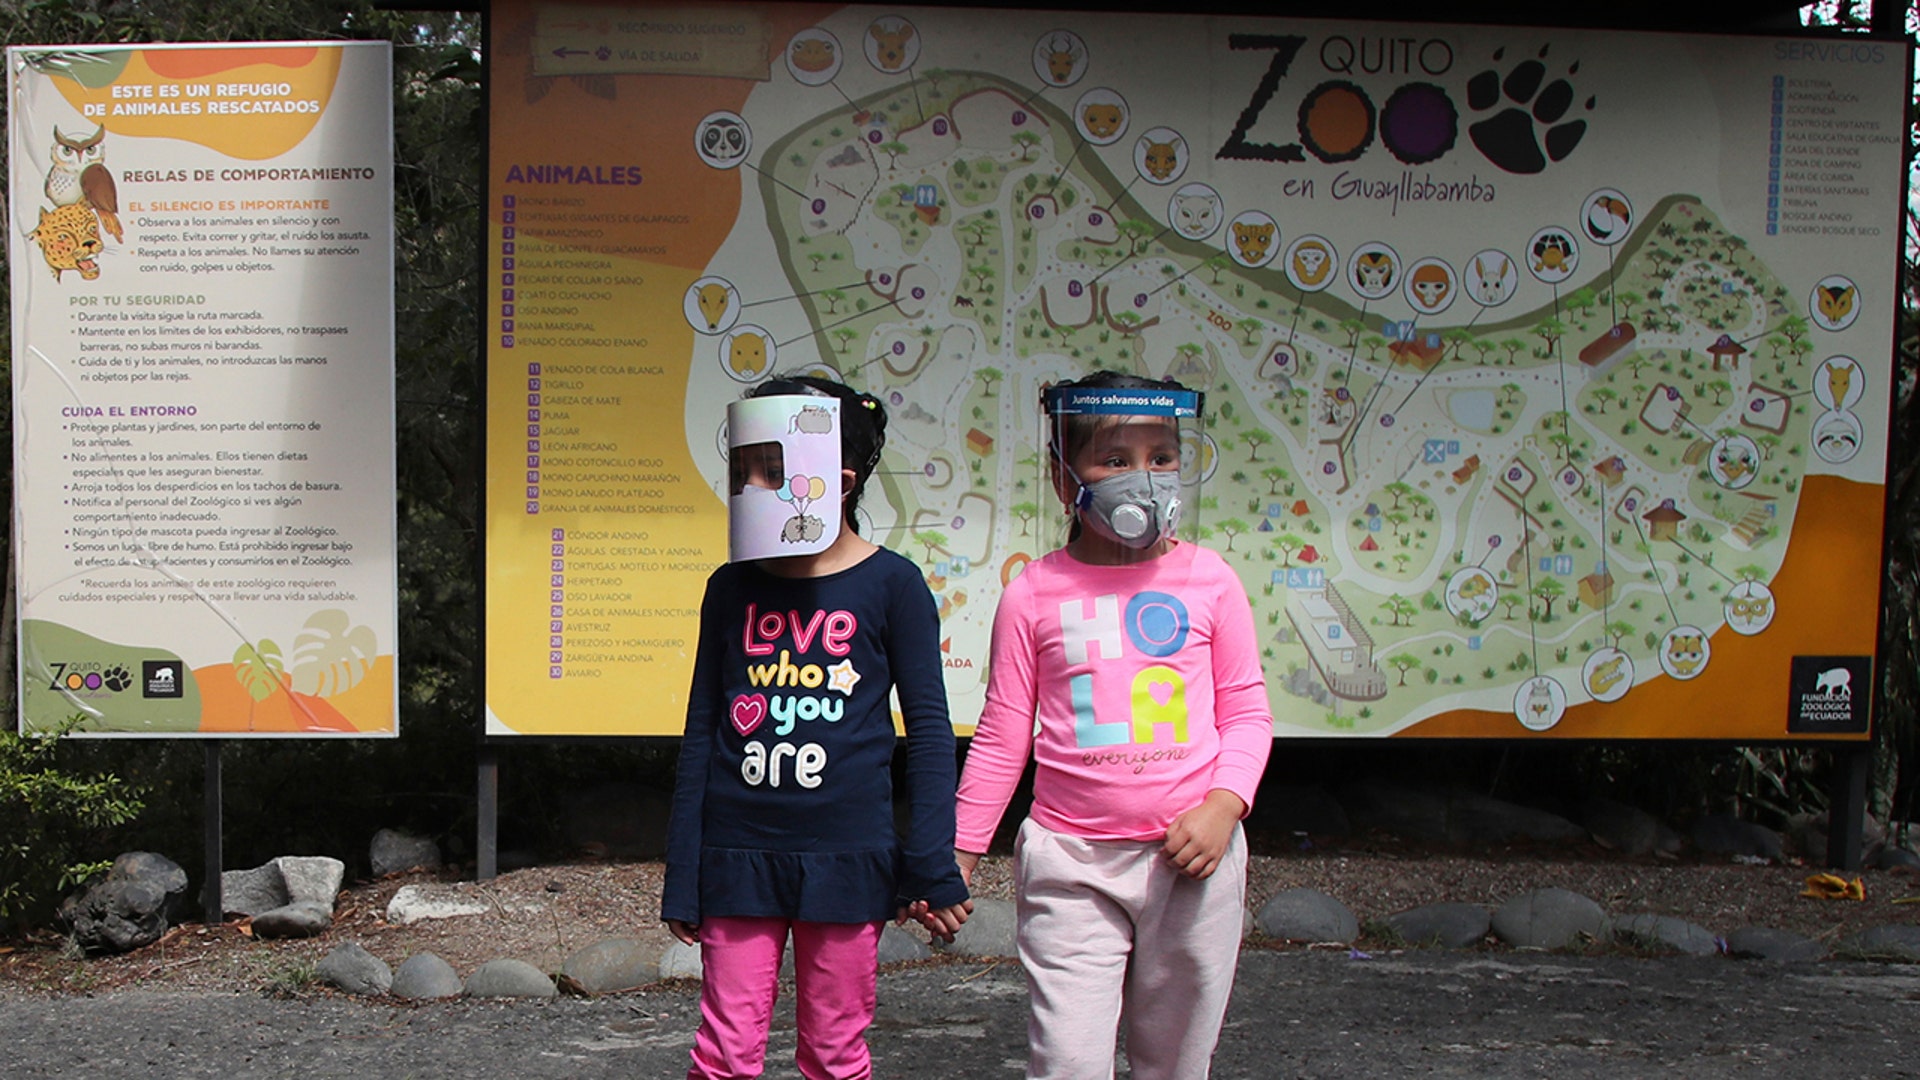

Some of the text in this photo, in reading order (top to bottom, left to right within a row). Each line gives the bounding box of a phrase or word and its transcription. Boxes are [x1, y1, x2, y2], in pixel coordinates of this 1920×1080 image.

[1320, 36, 1454, 76] QUITO
[1774, 41, 1885, 64] SERVICIOS
[112, 83, 291, 98] ESTE ES UN REFUGIO
[84, 100, 320, 116] DE ANIMALES RESCATADOS
[123, 167, 375, 183] REGLAS DE COMPORTAMIENTO
[505, 164, 642, 185] ANIMALES
[1283, 170, 1495, 216] en Guayllabamba
[129, 199, 330, 212] EL SILENCIO ES IMPORTANTE
[138, 217, 181, 227] Observa
[192, 216, 207, 226] los
[210, 216, 254, 226] animales
[256, 218, 270, 226] en
[272, 216, 310, 226] silencio
[312, 218, 319, 228] y
[321, 217, 340, 225] con
[70, 295, 206, 306] POR TU SEGURIDAD
[78, 310, 264, 323] Durante la visita sigue la ruta marcada.
[518, 307, 538, 315] OSO
[541, 307, 578, 315] ANDINO
[1206, 310, 1232, 331] ZOO
[518, 338, 556, 346] VENADO
[559, 338, 611, 347] COLORADO
[614, 339, 648, 347] ENANO
[600, 366, 625, 374] COLA
[545, 381, 584, 389] TIGRILLO
[544, 396, 579, 404] CABEZA
[596, 397, 621, 405] MATE
[1072, 395, 1100, 405] Juntos
[1102, 394, 1149, 406] salvamos
[61, 406, 197, 417] CUIDA EL ENTORNO
[70, 422, 110, 435] Protege
[112, 422, 147, 434] plantas
[149, 425, 155, 434] y
[157, 422, 197, 434] jardines,
[220, 423, 246, 433] parte
[248, 421, 264, 431] del
[266, 422, 306, 431] entorno
[308, 421, 321, 431] de
[544, 427, 579, 435] JAGUAR
[571, 443, 617, 451] AFRICANO
[543, 458, 574, 466] MONO
[576, 458, 636, 467] COTONCILLO
[71, 482, 102, 494] Arroja
[105, 483, 134, 492] todos
[137, 482, 152, 491] los
[154, 482, 218, 494] desperdicios
[236, 481, 251, 491] los
[253, 481, 287, 491] tachos
[289, 481, 303, 491] de
[305, 481, 342, 491] basura.
[543, 489, 573, 497] MONO
[576, 489, 614, 497] LANUDO
[611, 532, 648, 540] ANDINO
[567, 577, 622, 586] HERPETARIO
[590, 593, 632, 601] LAVADOR
[566, 623, 610, 631] AVESTRUZ
[70, 662, 102, 672] QUITO
[566, 669, 601, 677] AVIARIO
[748, 650, 824, 688] who
[770, 695, 844, 736] you
[742, 740, 826, 788] are
[1082, 750, 1190, 774] everyone
